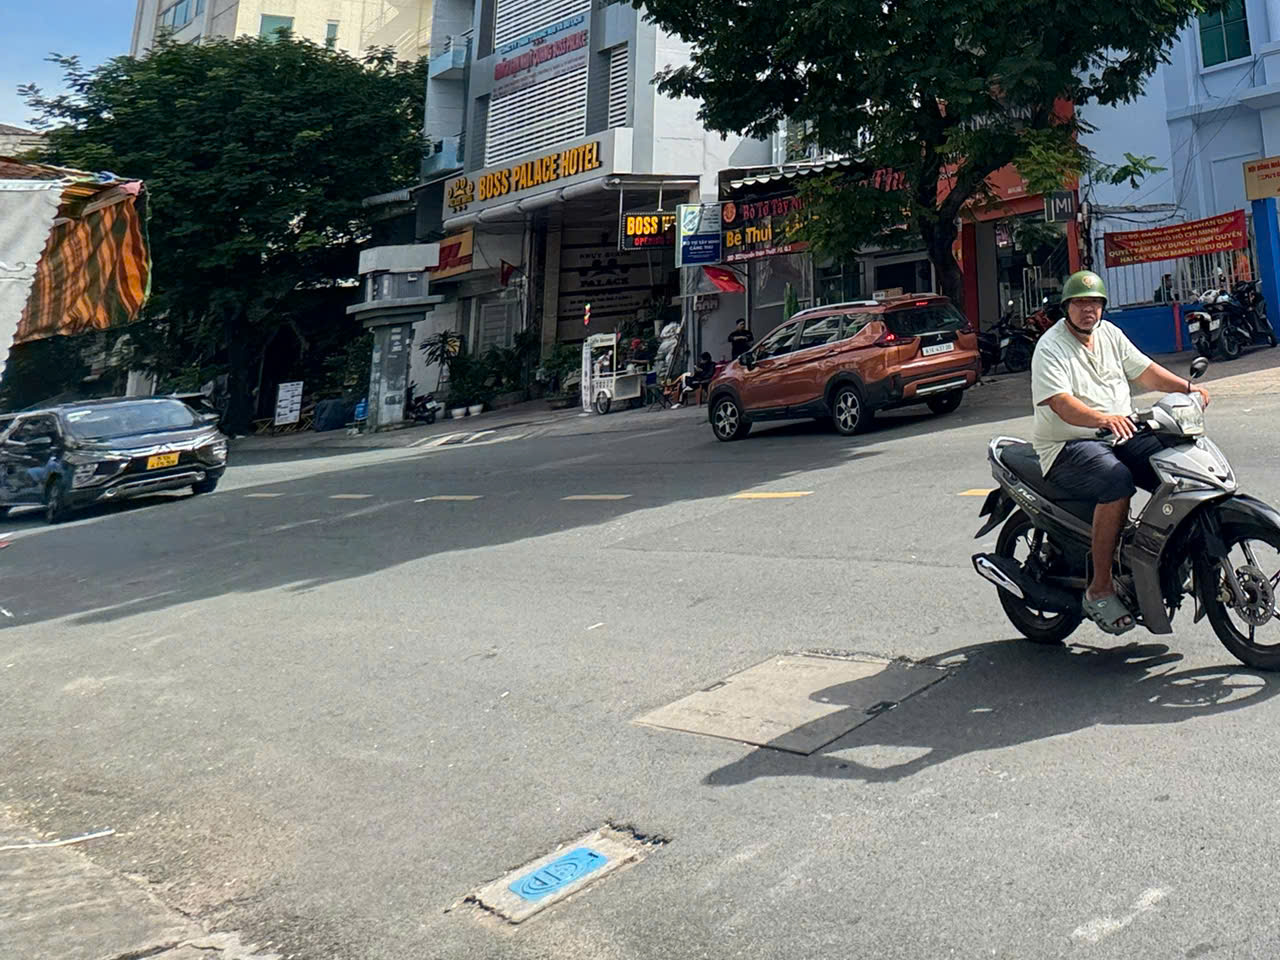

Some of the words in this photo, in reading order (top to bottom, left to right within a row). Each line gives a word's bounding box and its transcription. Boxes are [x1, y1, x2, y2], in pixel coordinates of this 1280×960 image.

[478, 168, 510, 201] BOSS
[512, 154, 558, 191] PALACE
[560, 141, 600, 176] HOTEL
[626, 215, 658, 235] BOSS
[745, 222, 772, 244] Thui
